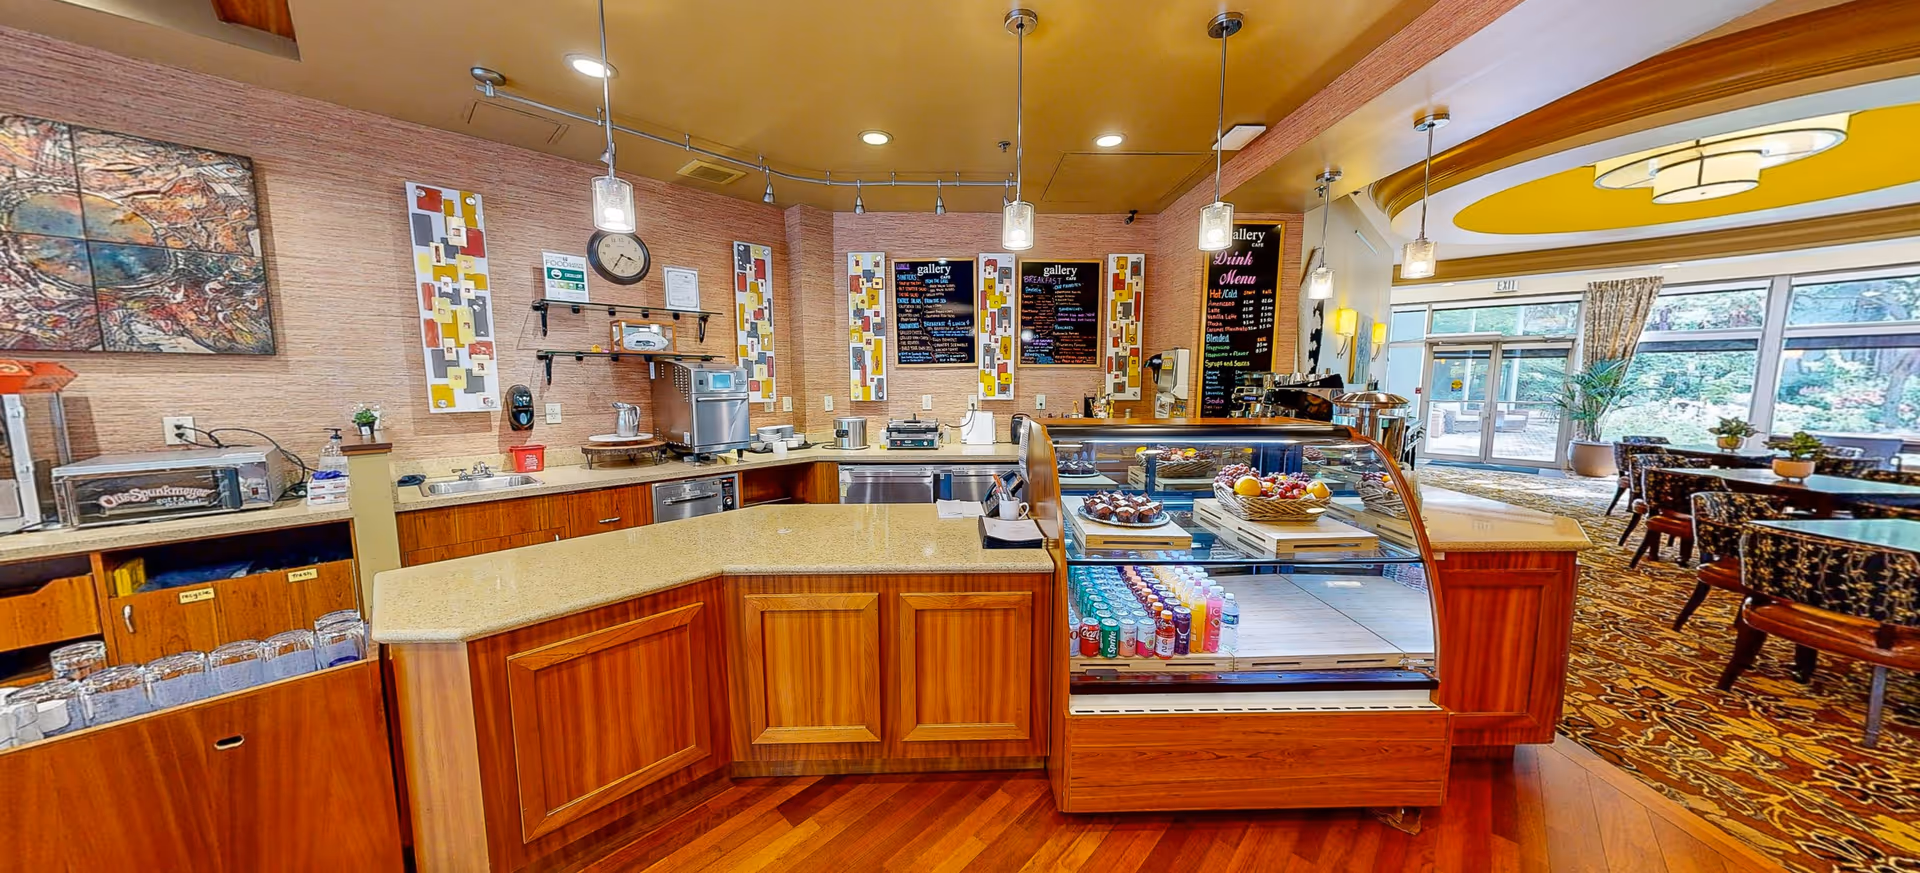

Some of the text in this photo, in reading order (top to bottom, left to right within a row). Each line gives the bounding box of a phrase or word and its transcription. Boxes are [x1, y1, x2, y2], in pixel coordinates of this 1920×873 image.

[1232, 228, 1266, 242] allery
[1213, 250, 1254, 266] Drink
[917, 264, 951, 276] gallery
[1044, 264, 1078, 276] gallery
[1024, 275, 1062, 284] BREAKFAST
[1220, 270, 1256, 284] Menu
[1497, 280, 1515, 290] EXIT
[1210, 289, 1238, 298] Hot/Cold
[1206, 334, 1230, 342] Blended
[128, 485, 216, 502] Spunkmeyer
[1210, 608, 1221, 616] IC
[1108, 631, 1117, 653] Sprite
